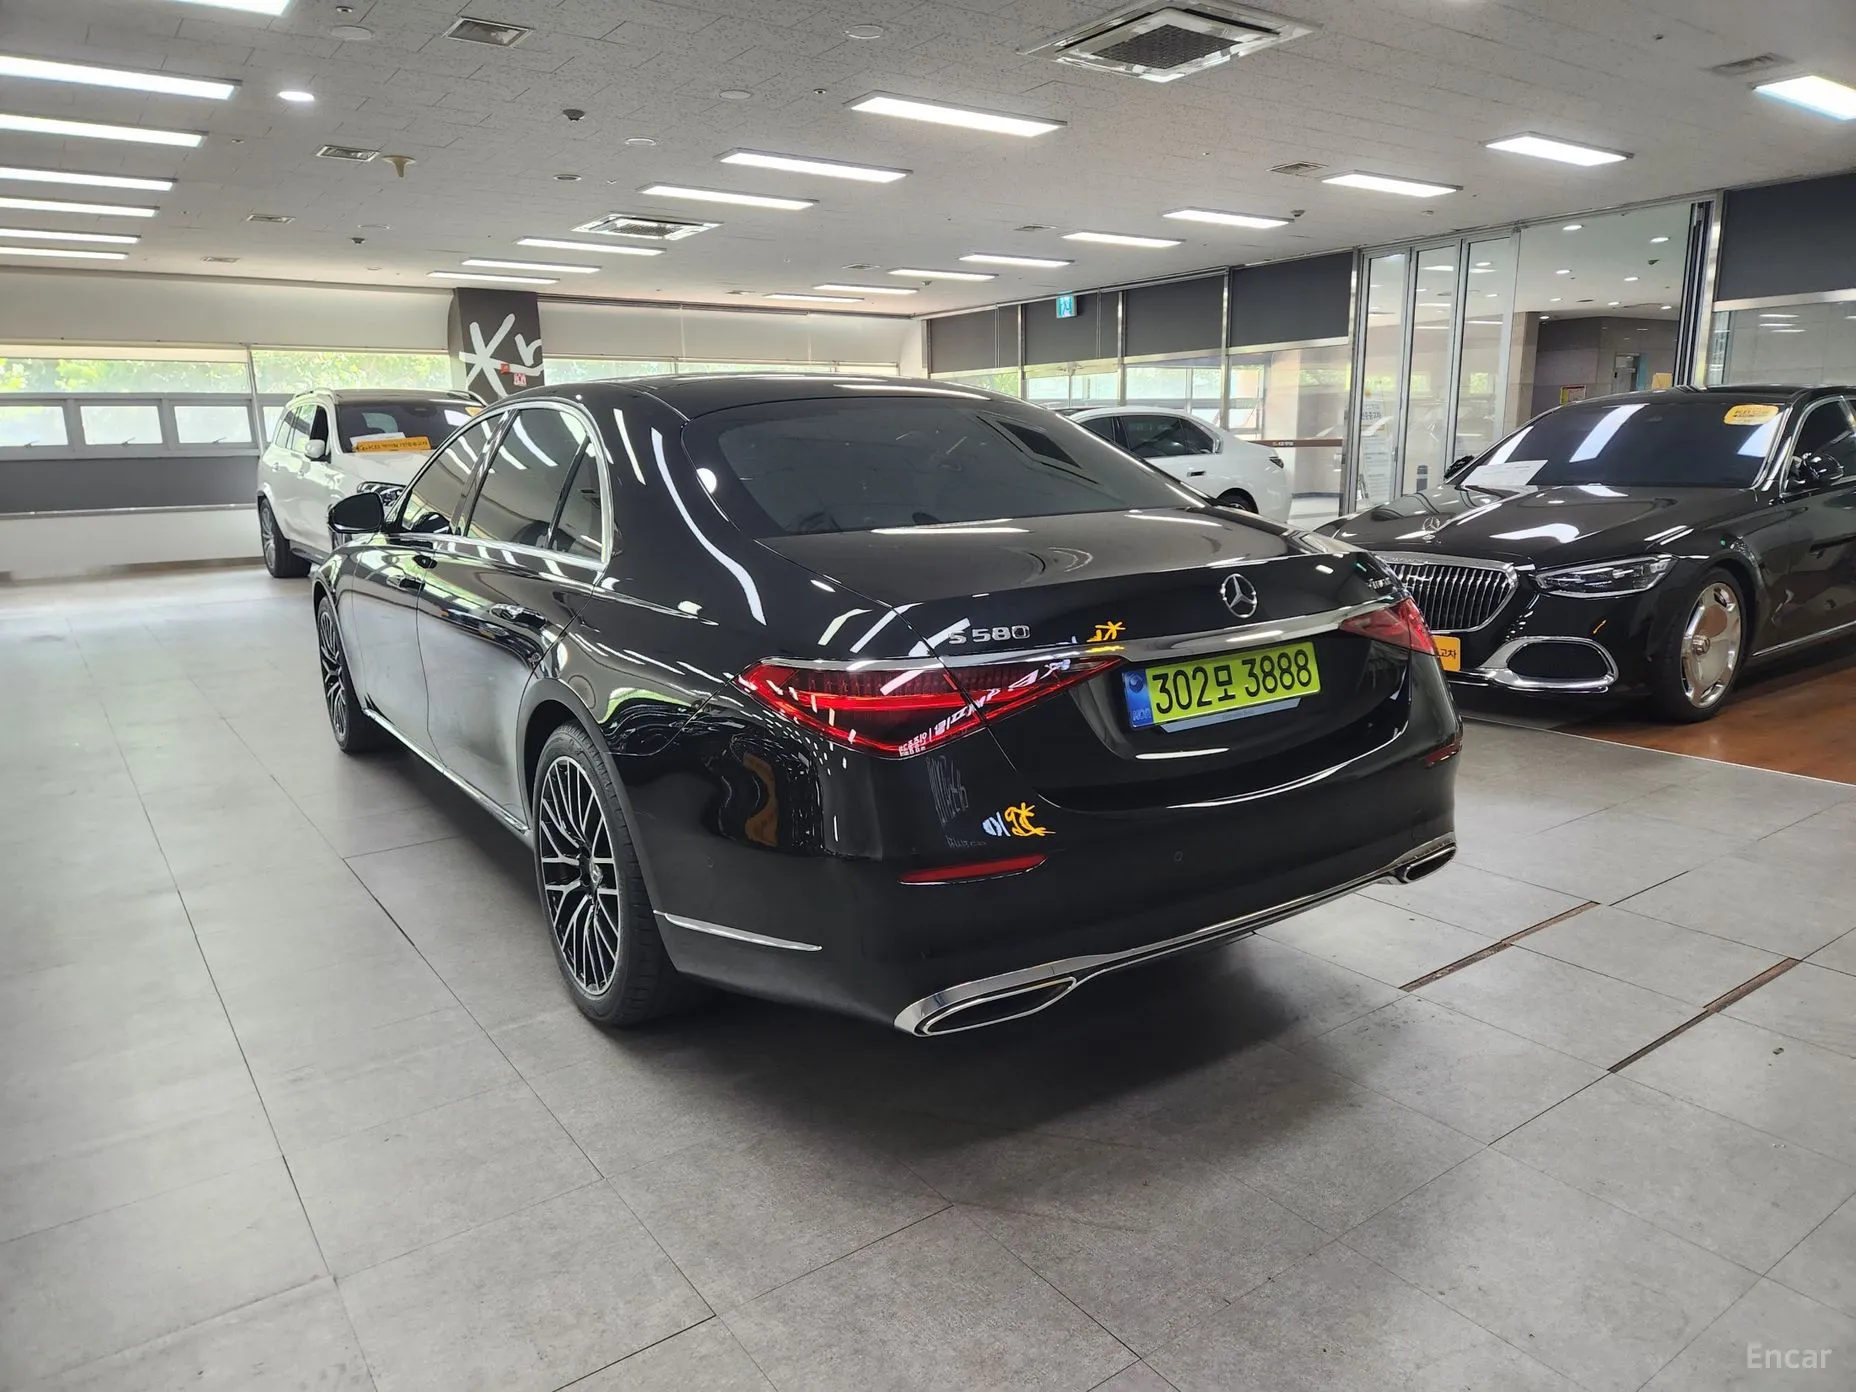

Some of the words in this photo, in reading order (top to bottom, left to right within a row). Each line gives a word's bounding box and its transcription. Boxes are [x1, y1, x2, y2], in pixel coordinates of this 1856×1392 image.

[948, 630, 967, 645] S
[972, 625, 1031, 642] 580
[1152, 664, 1235, 714] 302모
[1241, 649, 1312, 697] 3888
